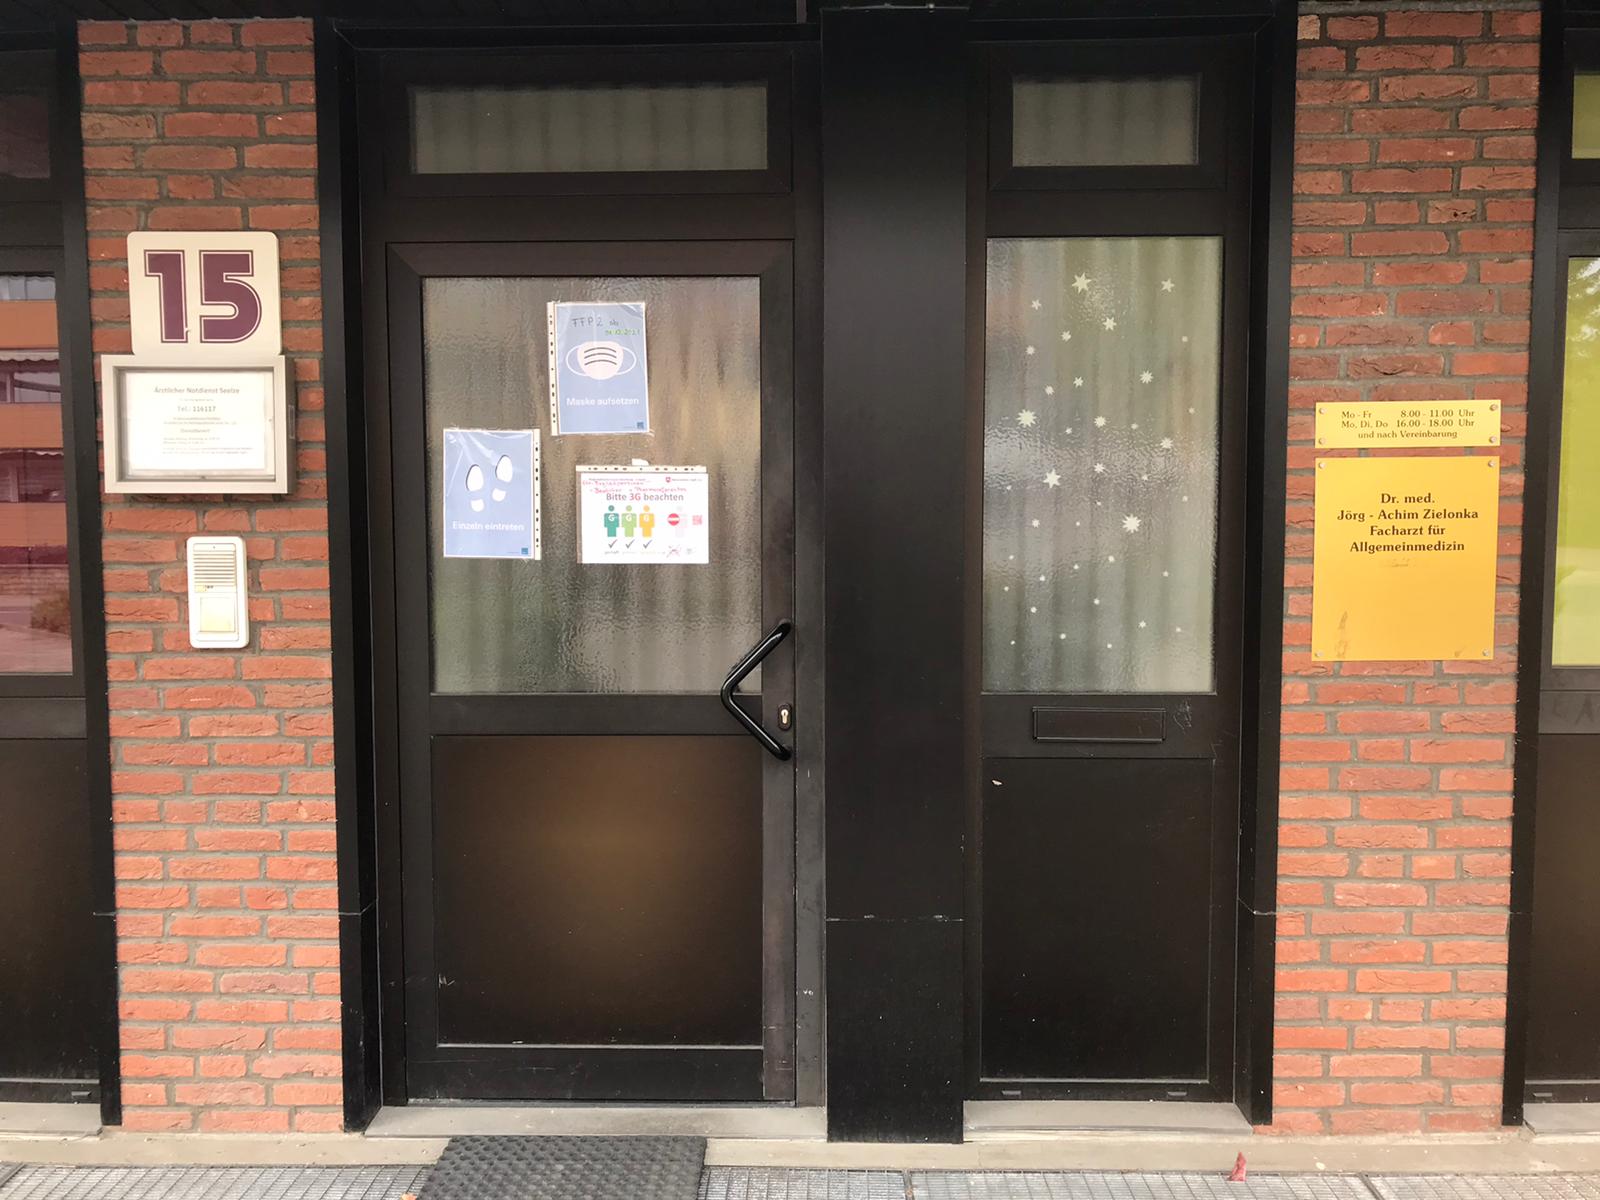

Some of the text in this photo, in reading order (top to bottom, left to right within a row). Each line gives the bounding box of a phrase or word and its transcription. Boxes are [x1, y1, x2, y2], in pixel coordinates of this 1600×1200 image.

[144, 250, 262, 343] 15
[566, 397, 640, 406] Maske aufsetzen
[1400, 410, 1421, 418] 8.00
[1430, 409, 1454, 417] 11.00
[1429, 419, 1454, 427] 18.00
[1400, 430, 1458, 438] Vereinbarung
[606, 493, 684, 501] Bitte 3G beachten
[1381, 493, 1435, 503] Dr. med.
[1337, 510, 1365, 522] Jörg
[1378, 509, 1418, 520] Achim
[1423, 508, 1479, 519] Zielonka
[452, 520, 525, 531] Einzeln eintreten
[1370, 525, 1445, 536] Facharzt für
[1350, 540, 1465, 554] Allgemeinmedizin
